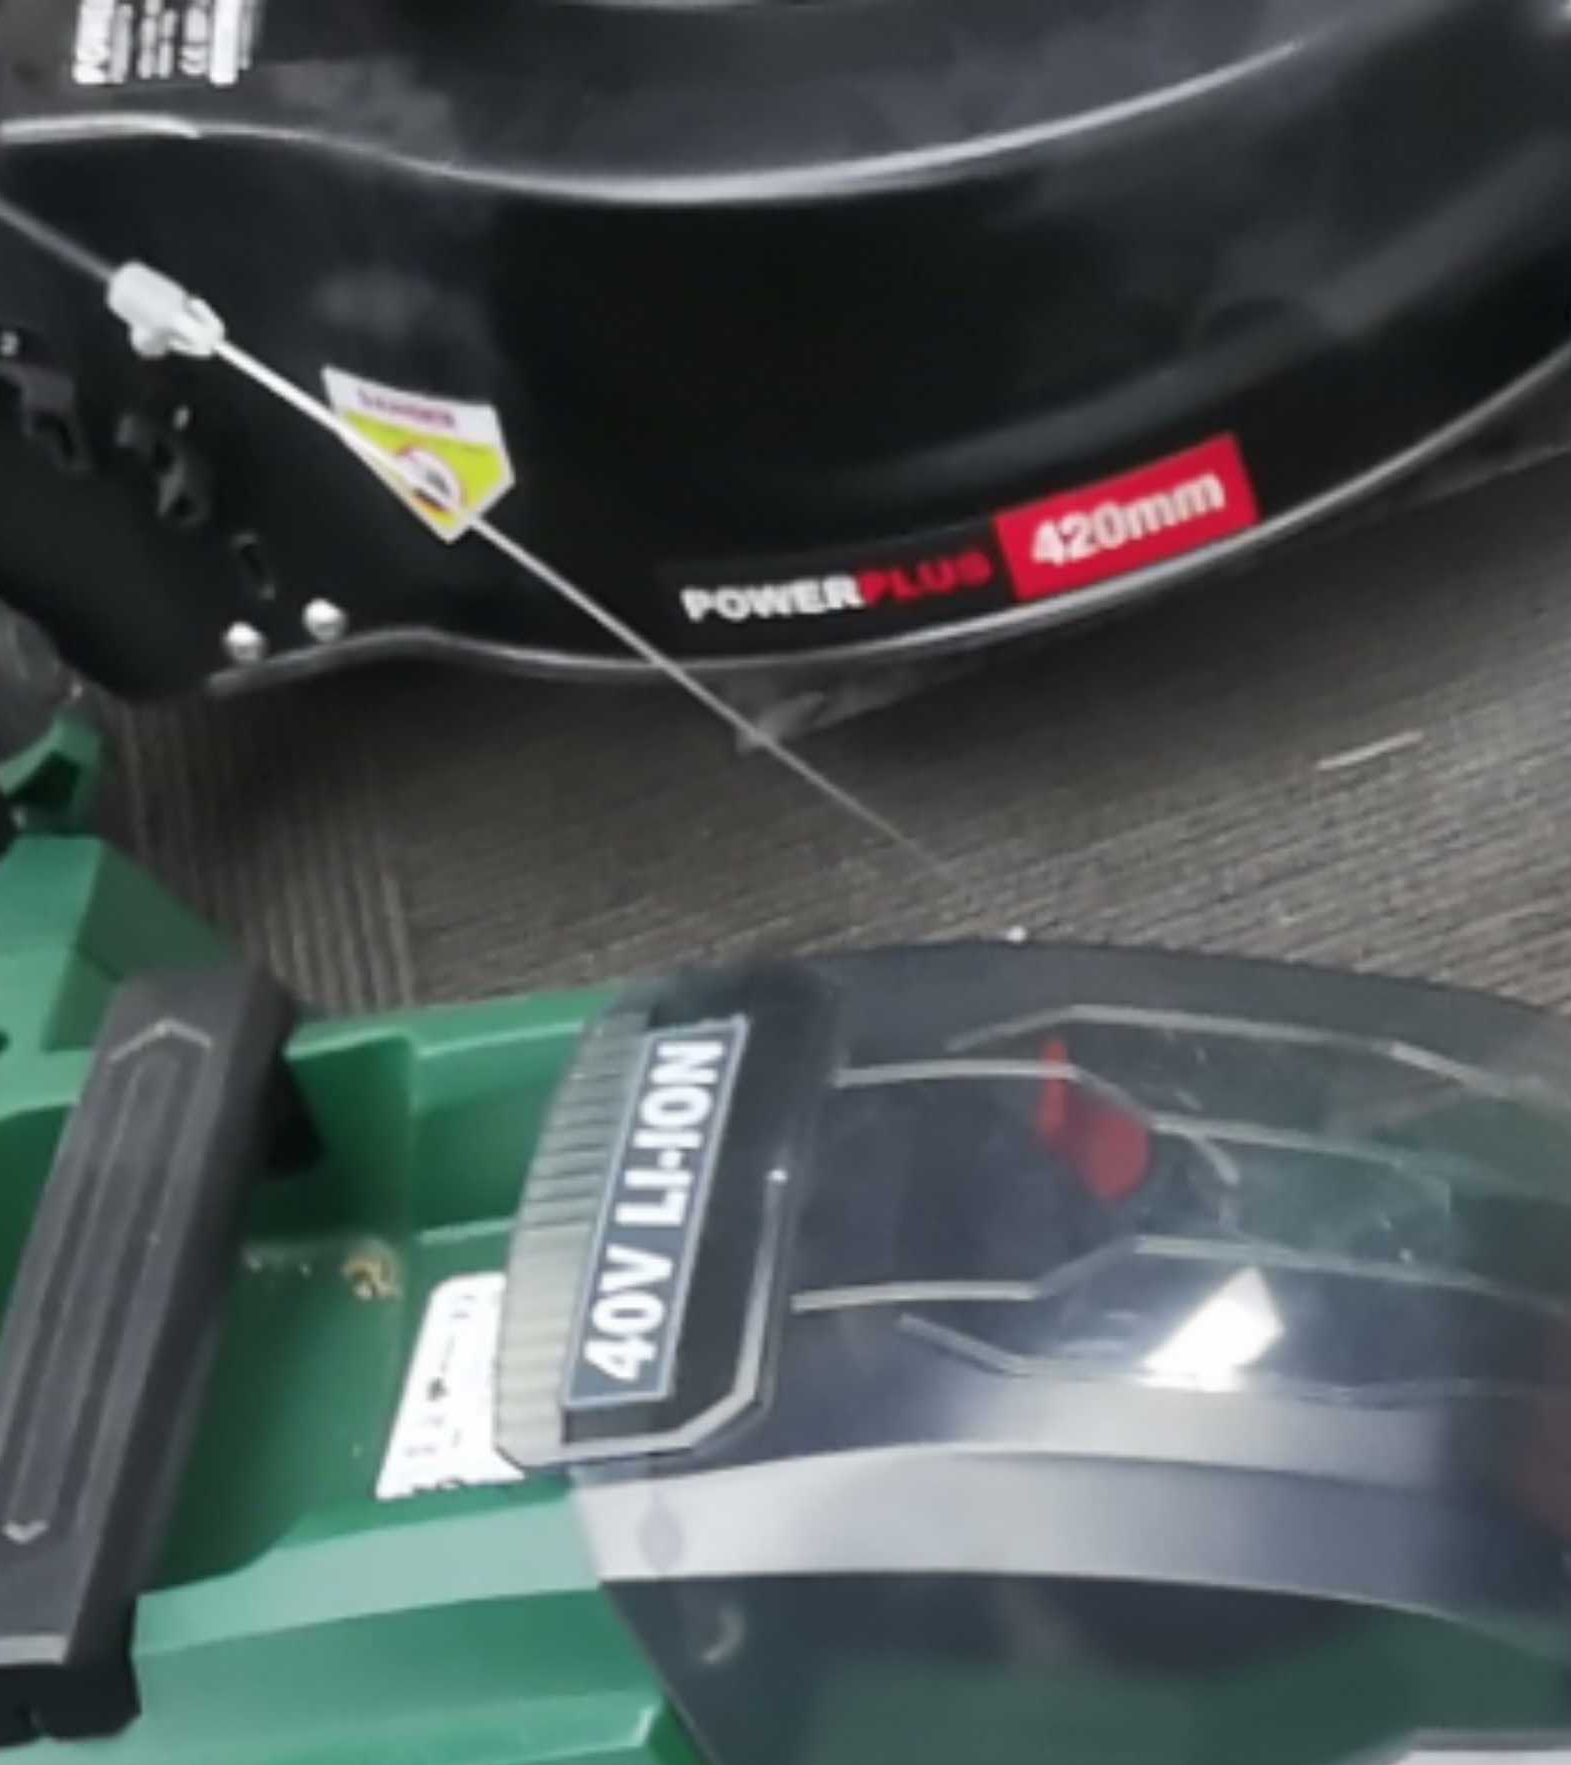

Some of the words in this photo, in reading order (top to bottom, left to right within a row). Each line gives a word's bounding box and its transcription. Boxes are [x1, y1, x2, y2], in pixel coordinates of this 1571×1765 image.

[679, 549, 995, 623] POWERPLUS
[1028, 471, 1229, 568] 420mm
[613, 1039, 726, 1229] LI-ION
[582, 1241, 676, 1383] 40V
